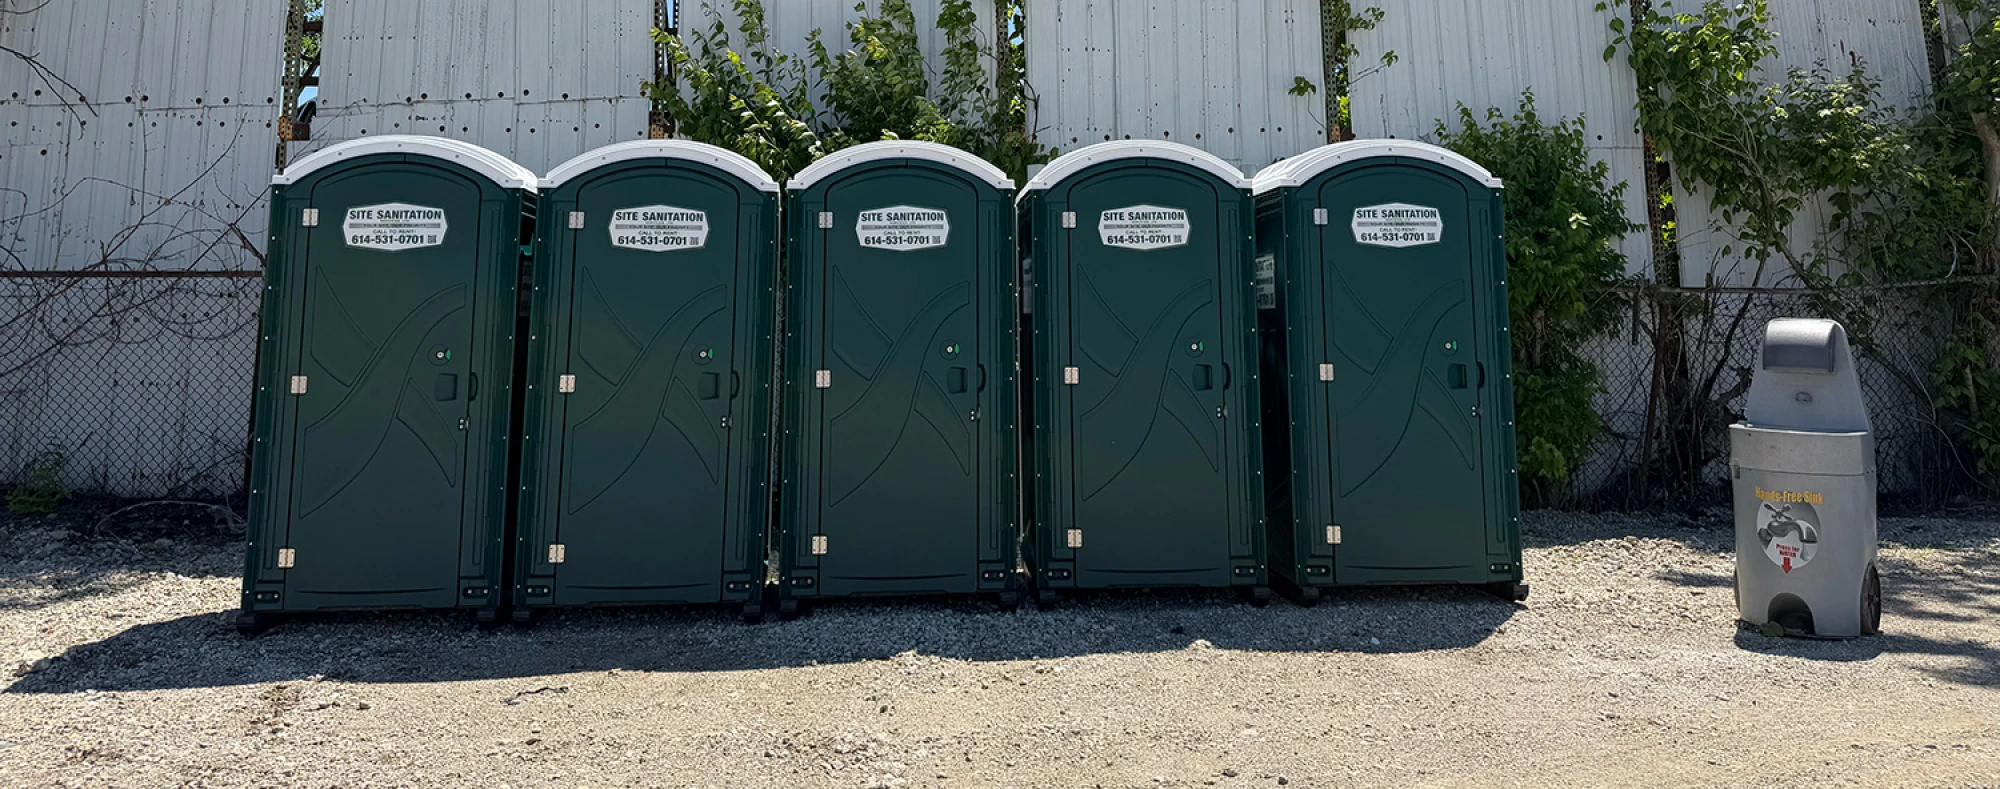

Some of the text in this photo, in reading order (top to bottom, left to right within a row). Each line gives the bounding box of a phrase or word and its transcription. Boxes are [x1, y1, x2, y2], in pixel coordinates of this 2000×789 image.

[349, 210, 441, 219] SITE SANITATION
[615, 211, 703, 221] SITE SANITATION
[861, 212, 944, 221] SITE SANITATION
[1103, 211, 1184, 221] SITE SANITATION
[1356, 209, 1437, 218] SITE SANITATION
[352, 234, 424, 244] 614-531-0701
[618, 235, 687, 245] 614-531-0701
[864, 236, 930, 245] 614-531-0701
[1107, 235, 1171, 244] 614-531-0701
[1360, 232, 1425, 241] 614-531-0701
[1755, 486, 1823, 505] Hands-Free Sink
